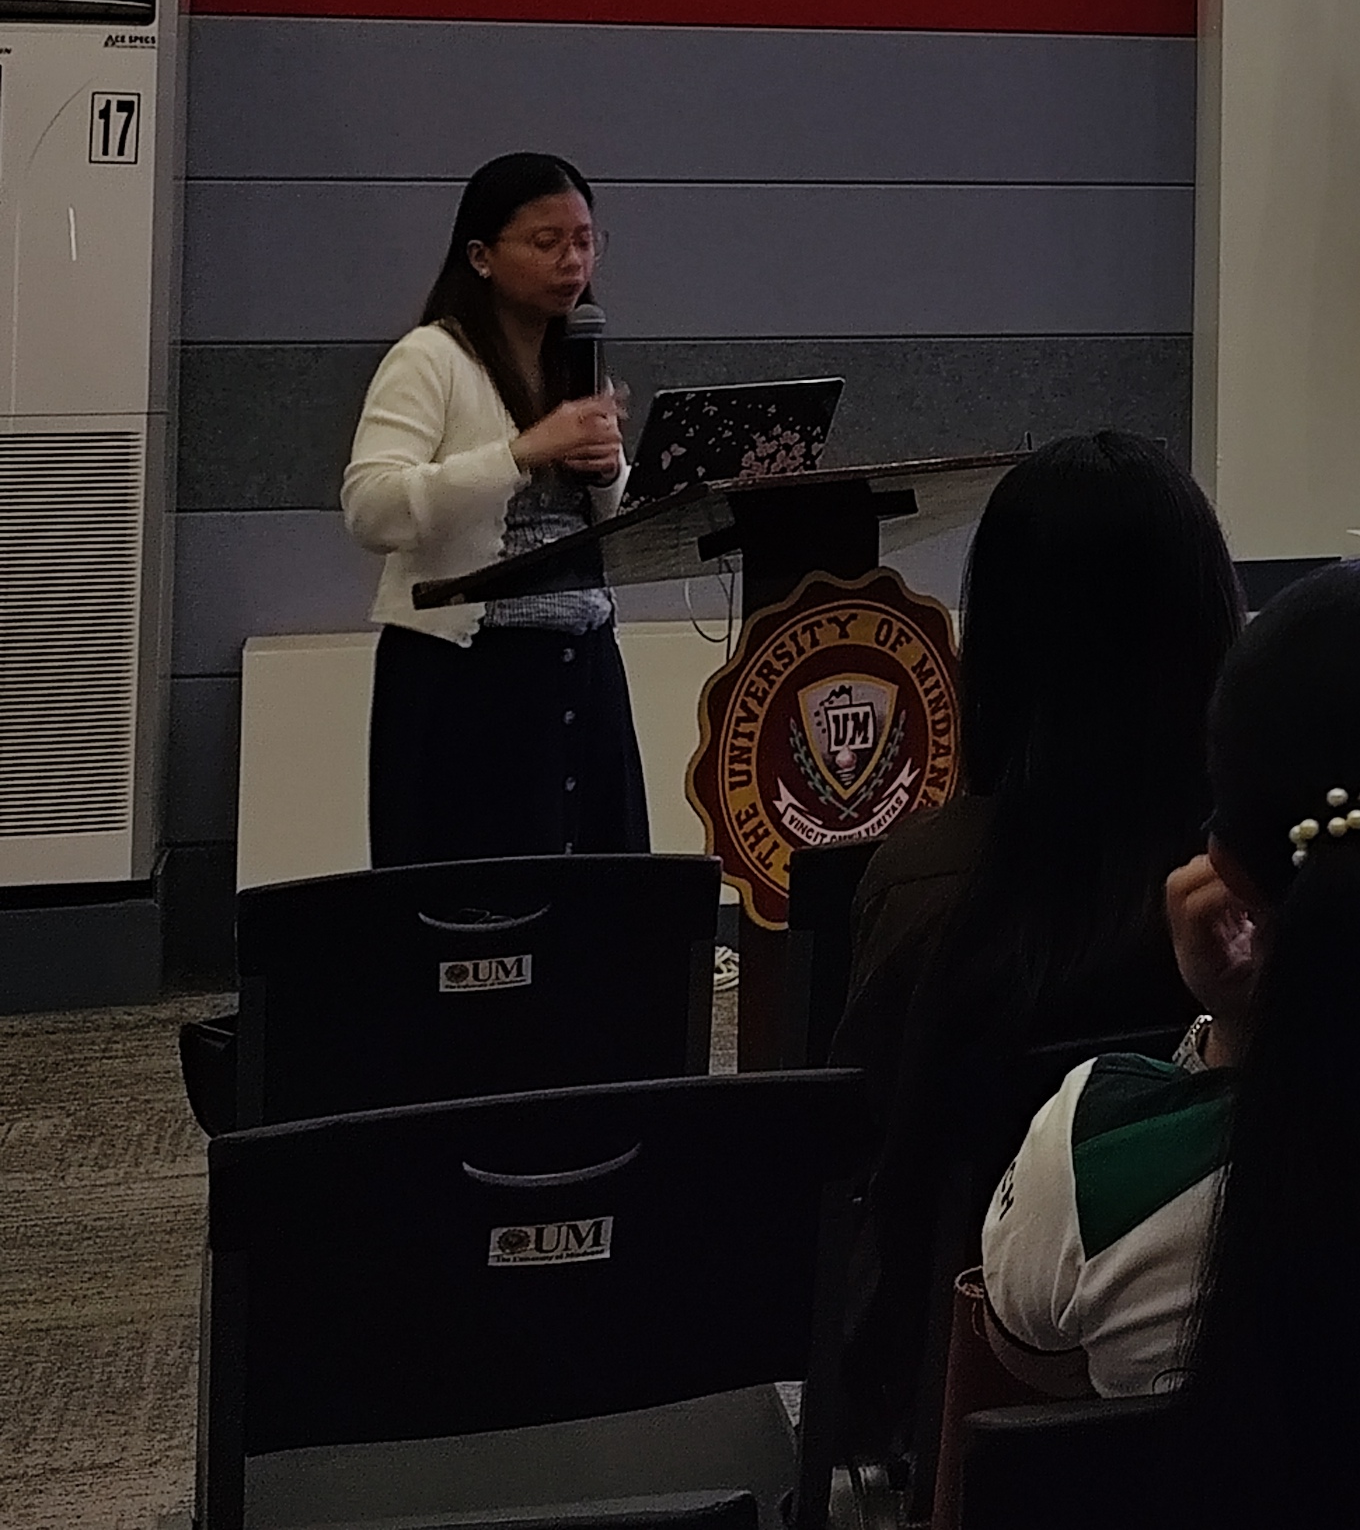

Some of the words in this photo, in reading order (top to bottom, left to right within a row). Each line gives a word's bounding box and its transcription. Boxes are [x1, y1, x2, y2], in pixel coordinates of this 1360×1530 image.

[98, 99, 136, 157] 17
[874, 617, 912, 653] OF
[728, 613, 858, 791] UNIVERSITY
[832, 711, 870, 747] UM
[911, 653, 951, 807] MINDANA
[736, 801, 781, 872] THE
[788, 814, 828, 844] VINCIT
[864, 796, 904, 838] VERITAS
[472, 957, 524, 982] UM
[534, 1220, 605, 1254] UM
